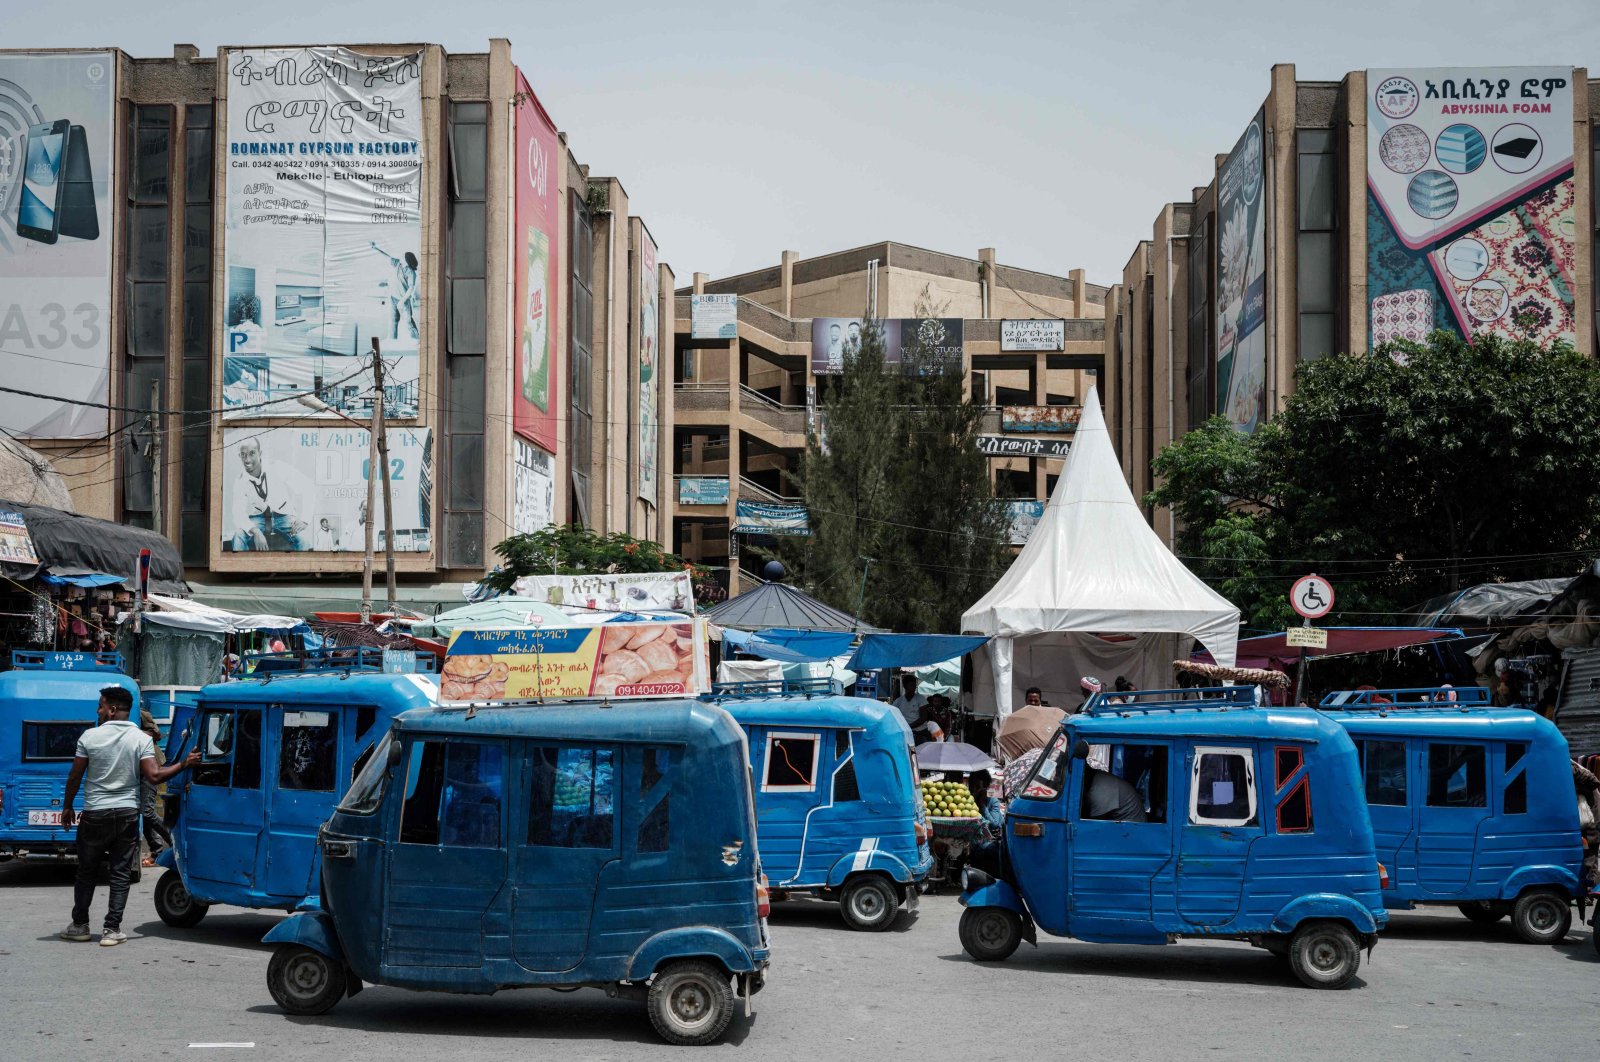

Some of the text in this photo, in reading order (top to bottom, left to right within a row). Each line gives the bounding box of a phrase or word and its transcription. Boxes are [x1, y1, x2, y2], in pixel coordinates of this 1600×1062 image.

[232, 55, 348, 86] ፋብሪካ
[1425, 78, 1566, 100] አቢሲንያ ፎም
[1387, 95, 1407, 106] AF
[245, 96, 404, 134] ሮማናት
[1441, 103, 1551, 115] ABYSSINIA FOAM
[231, 141, 418, 155] ROMANAT GYPSUM FACTORY
[232, 160, 250, 168] Call.
[252, 160, 272, 168] 0342
[273, 160, 303, 168] 405422
[309, 160, 329, 168] 0914
[331, 160, 360, 168] 310335
[367, 160, 386, 168] 0914
[388, 160, 418, 168] 300806
[276, 172, 322, 181] Mekelle
[334, 172, 384, 182] Ethiopia
[374, 197, 405, 208] Mold
[371, 212, 408, 224] Chalk
[0, 302, 101, 349] A33
[571, 576, 606, 594] እናት
[61, 661, 74, 670] 17
[618, 684, 680, 696] 0914047022
